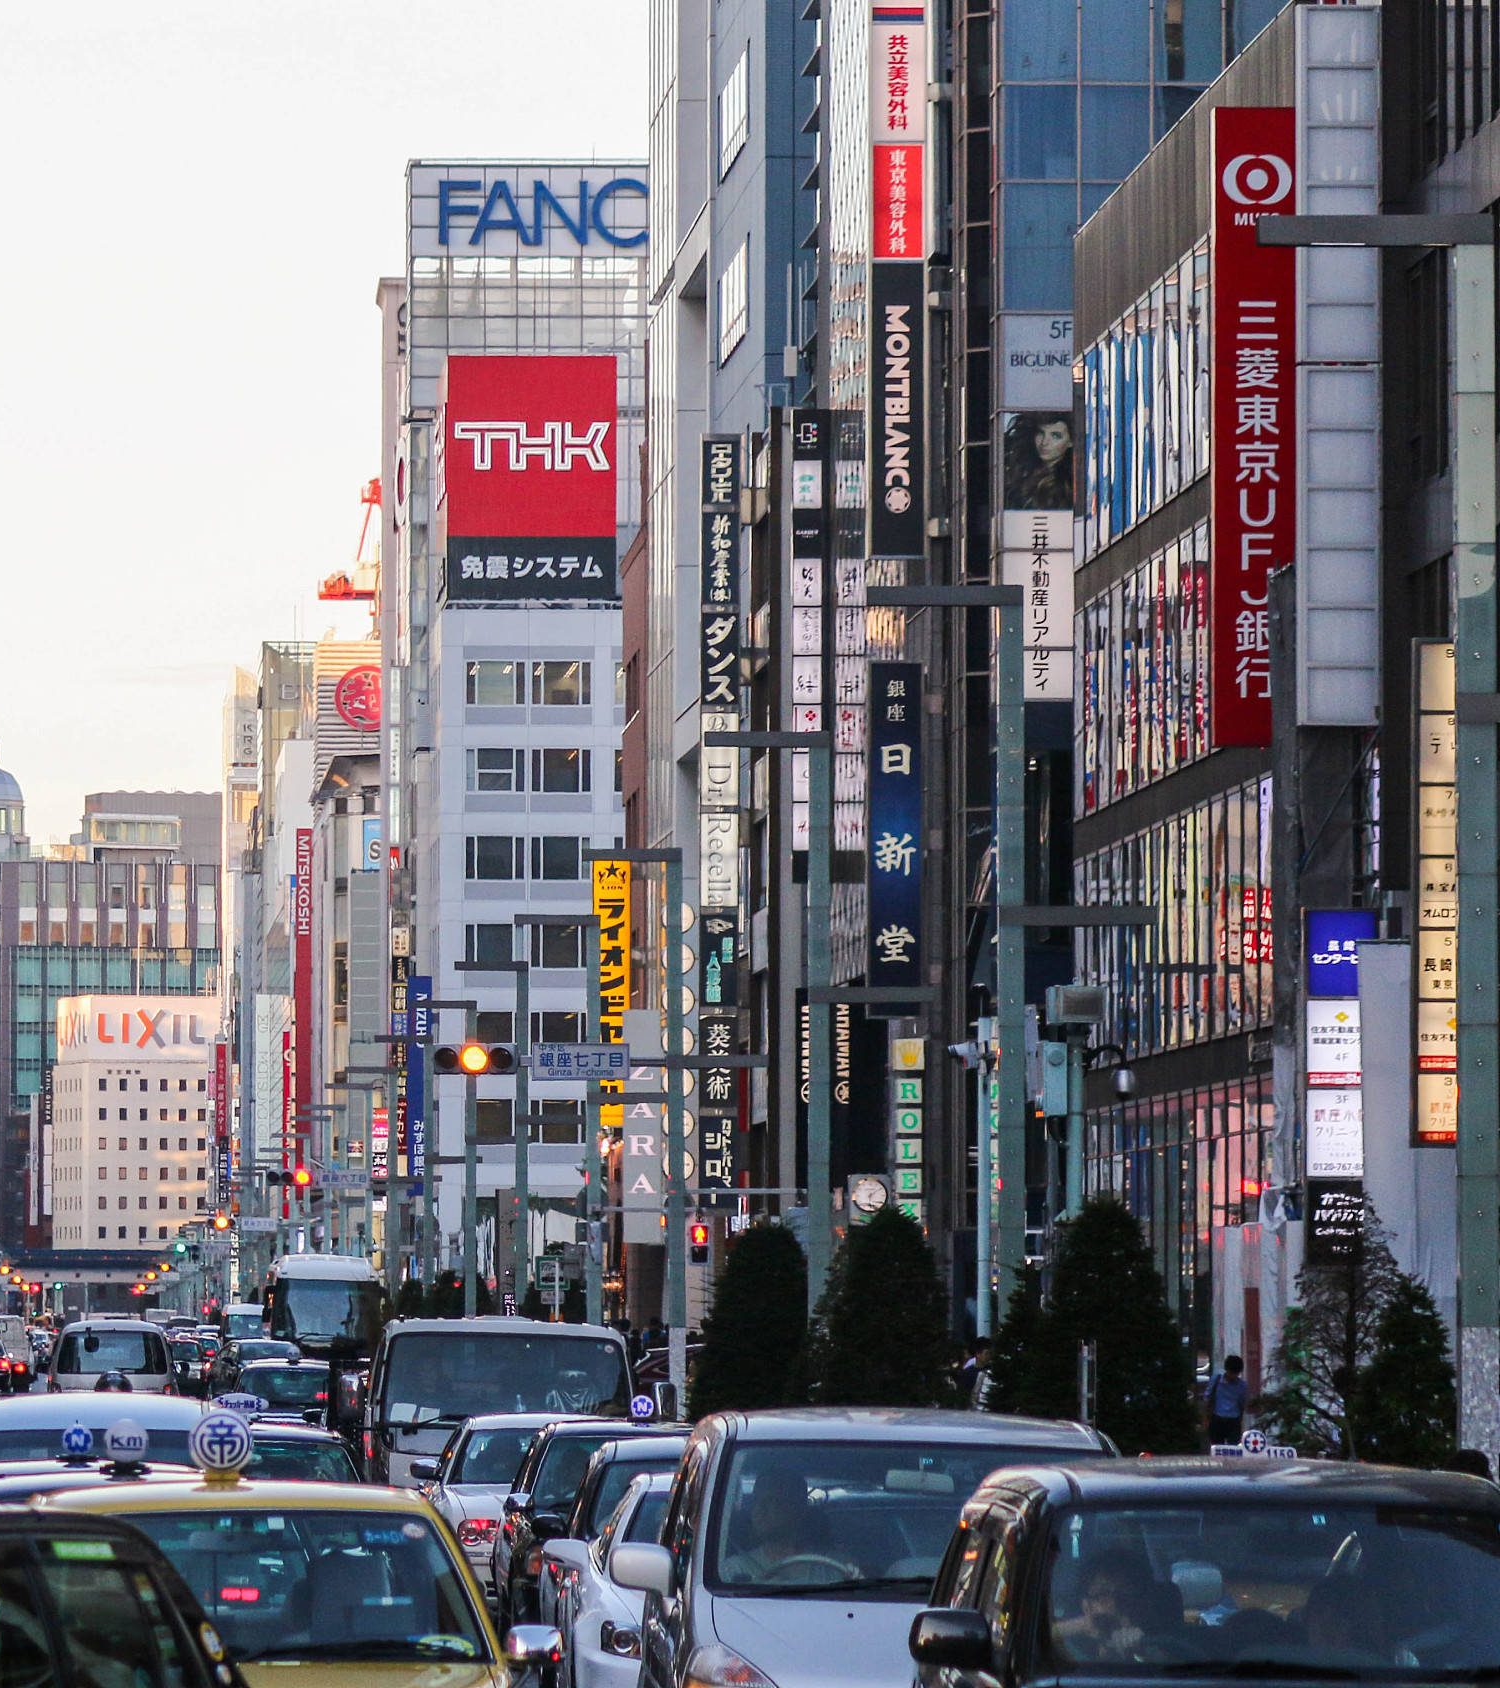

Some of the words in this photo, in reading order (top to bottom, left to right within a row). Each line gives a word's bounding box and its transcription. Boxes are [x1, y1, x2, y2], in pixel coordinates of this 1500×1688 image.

[887, 34, 909, 131] 共立美容外科
[437, 178, 650, 249] FANC
[887, 148, 908, 255] 東京美容外科
[1233, 212, 1280, 226] MU
[1049, 320, 1073, 340] 5F
[1009, 353, 1072, 368] BIGUINE
[884, 304, 912, 488] MONTBLANC
[453, 420, 612, 472] THK
[459, 554, 605, 581] 免震システム
[1030, 515, 1051, 692] 三井不動産リアルティ
[704, 615, 737, 703] ダンス
[886, 679, 906, 722] 銀座
[706, 764, 732, 802] Dr.
[706, 814, 732, 906] Recella
[874, 742, 918, 965] 日新堂
[297, 834, 311, 936] MITSUKOSHI
[1443, 937, 1453, 947] 5
[1423, 958, 1453, 972] 長崎
[1432, 979, 1454, 990] 東京
[97, 1008, 206, 1049] LIXIL
[538, 1052, 624, 1068] 銀座七丁目
[547, 1067, 573, 1077] Ginza
[575, 1067, 615, 1077] 7-chome
[1335, 1094, 1349, 1105] 3F
[1443, 1077, 1453, 1086] 3
[628, 1065, 657, 1194] ZARA
[900, 1082, 920, 1222] ROLEX
[110, 1433, 143, 1450] km
